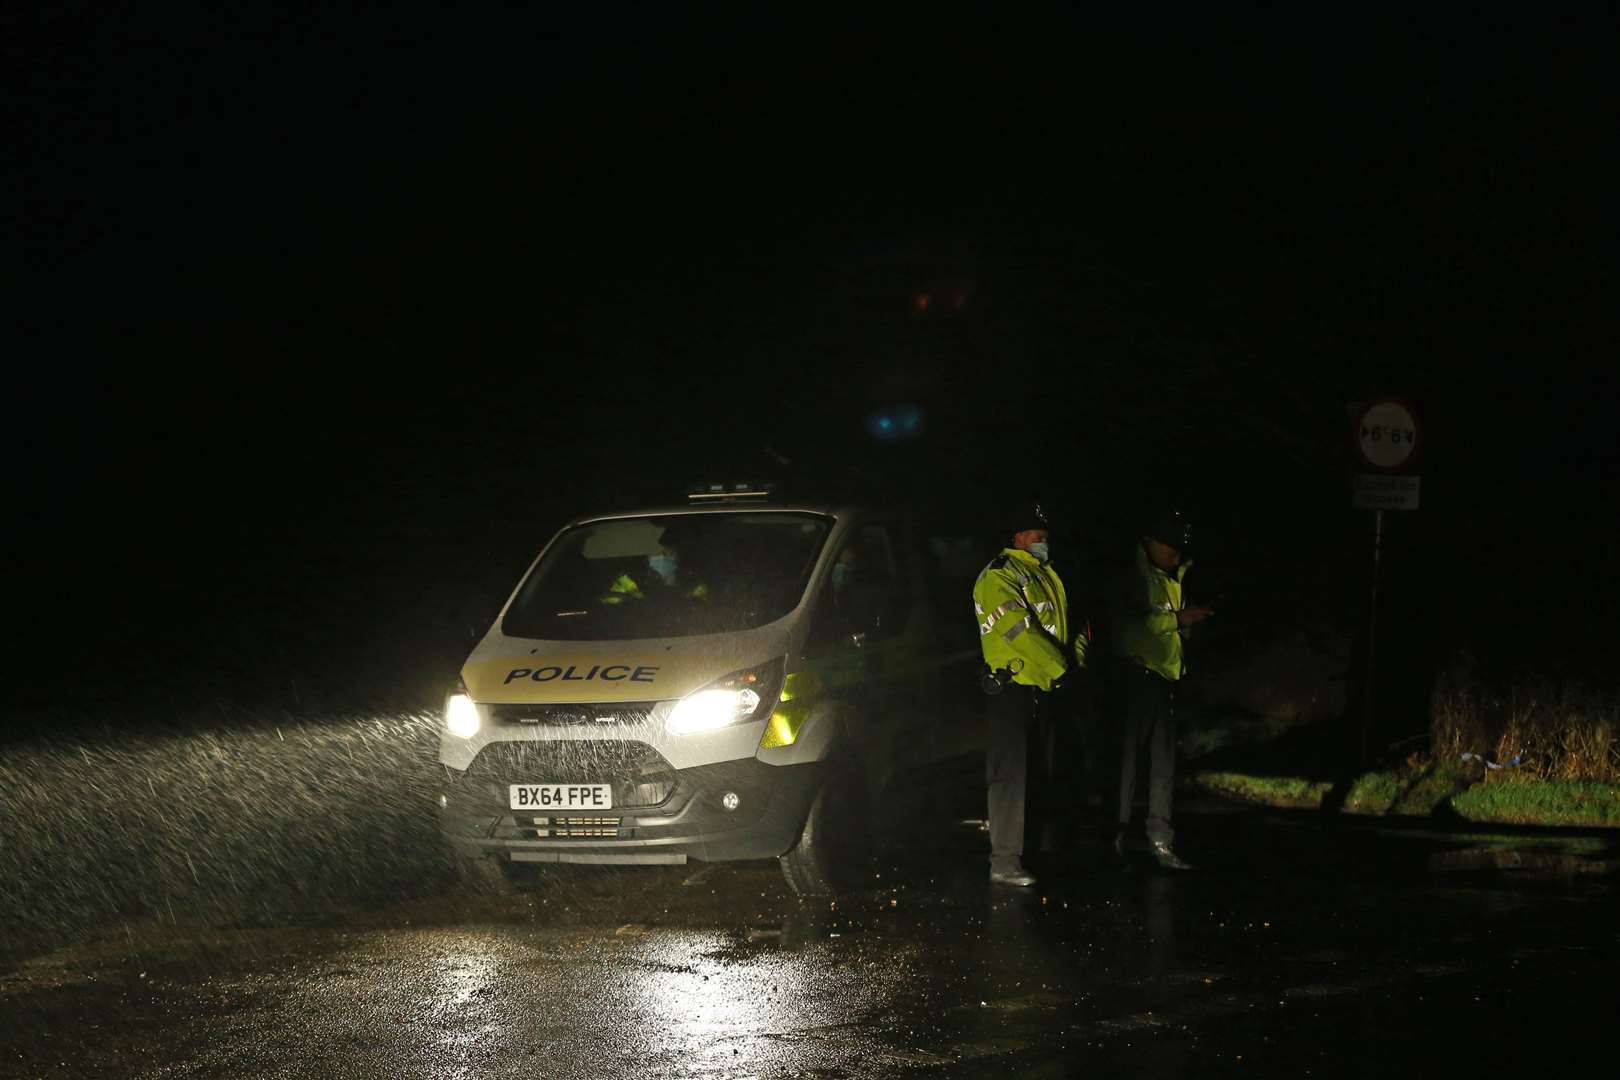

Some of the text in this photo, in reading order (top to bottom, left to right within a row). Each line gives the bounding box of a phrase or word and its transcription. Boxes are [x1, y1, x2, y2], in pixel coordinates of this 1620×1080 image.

[503, 665, 660, 685] POLICE
[518, 788, 603, 806] BX64 FPE
